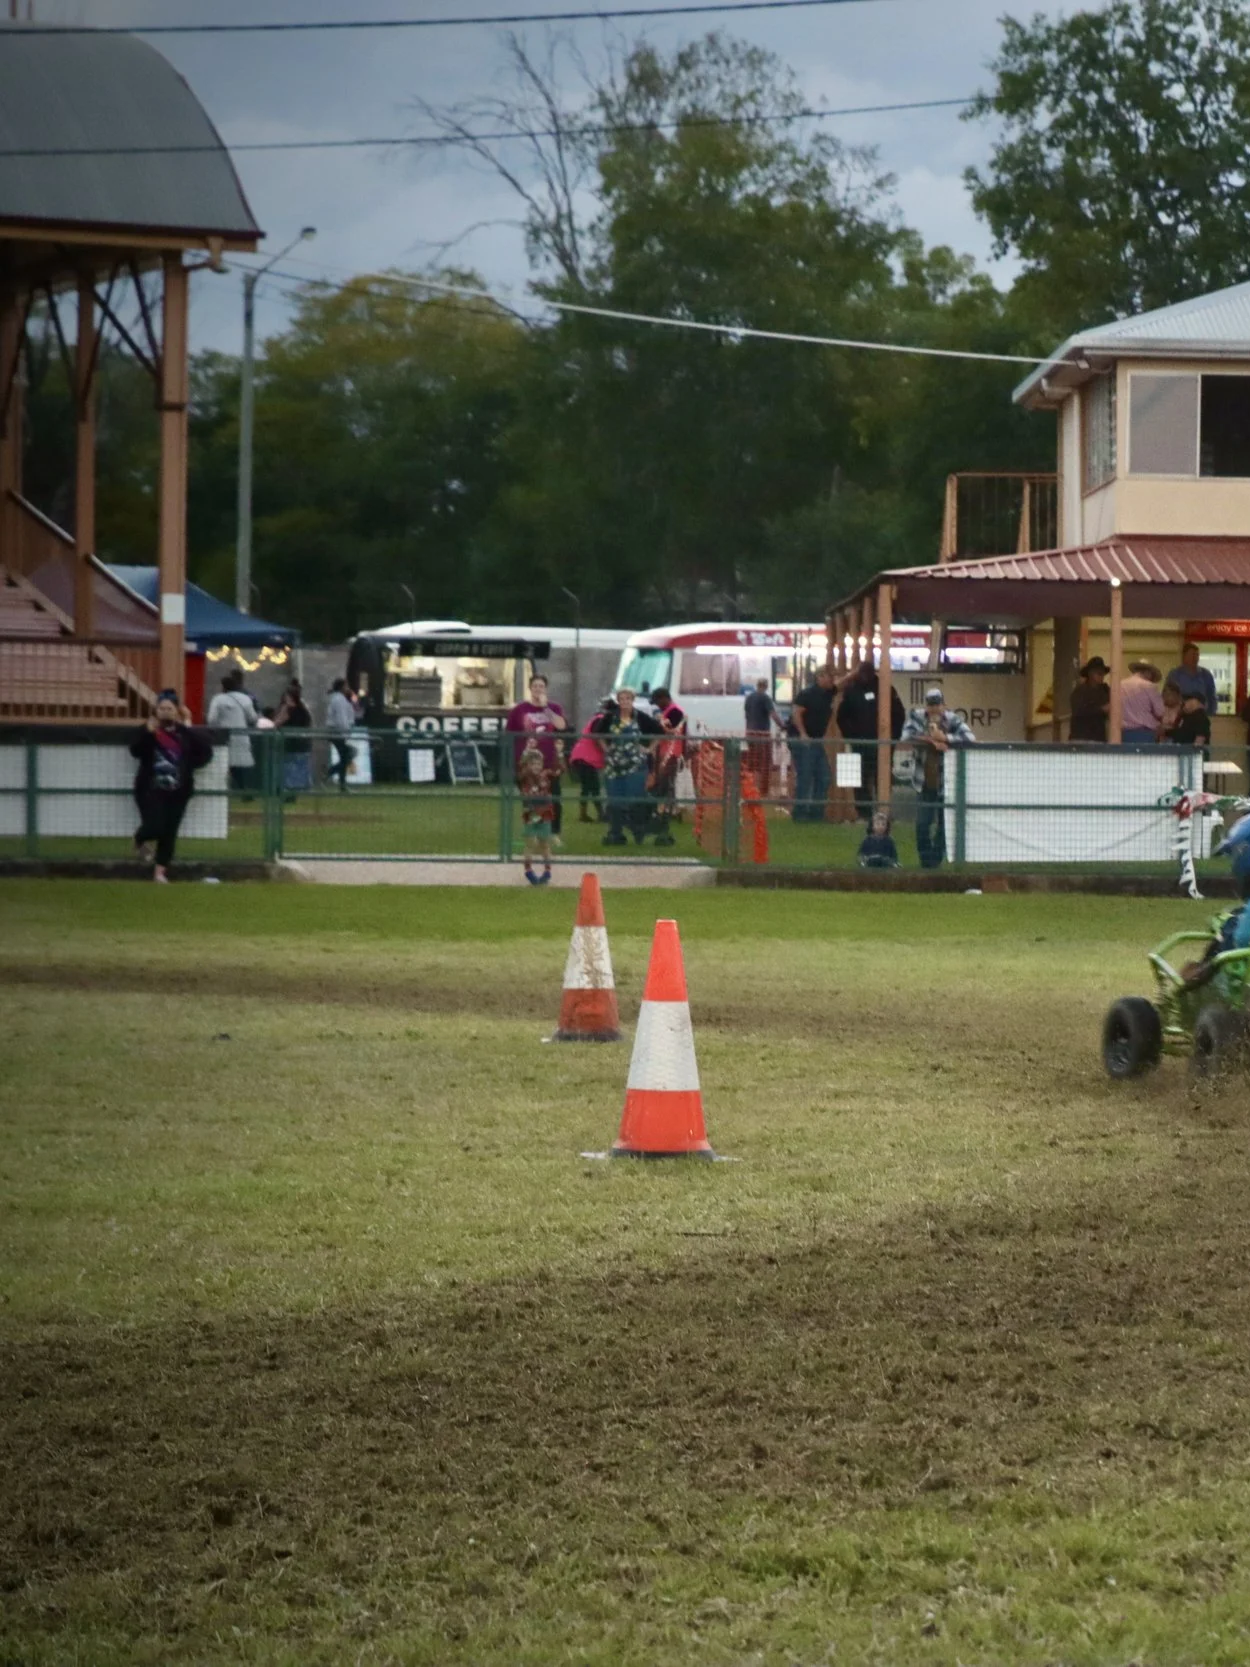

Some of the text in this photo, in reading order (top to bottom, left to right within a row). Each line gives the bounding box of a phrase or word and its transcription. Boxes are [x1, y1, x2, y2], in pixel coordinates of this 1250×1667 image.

[1234, 623, 1247, 633] ice
[888, 634, 926, 646] ream
[953, 708, 1002, 726] ORP
[396, 716, 508, 738] COFFE
